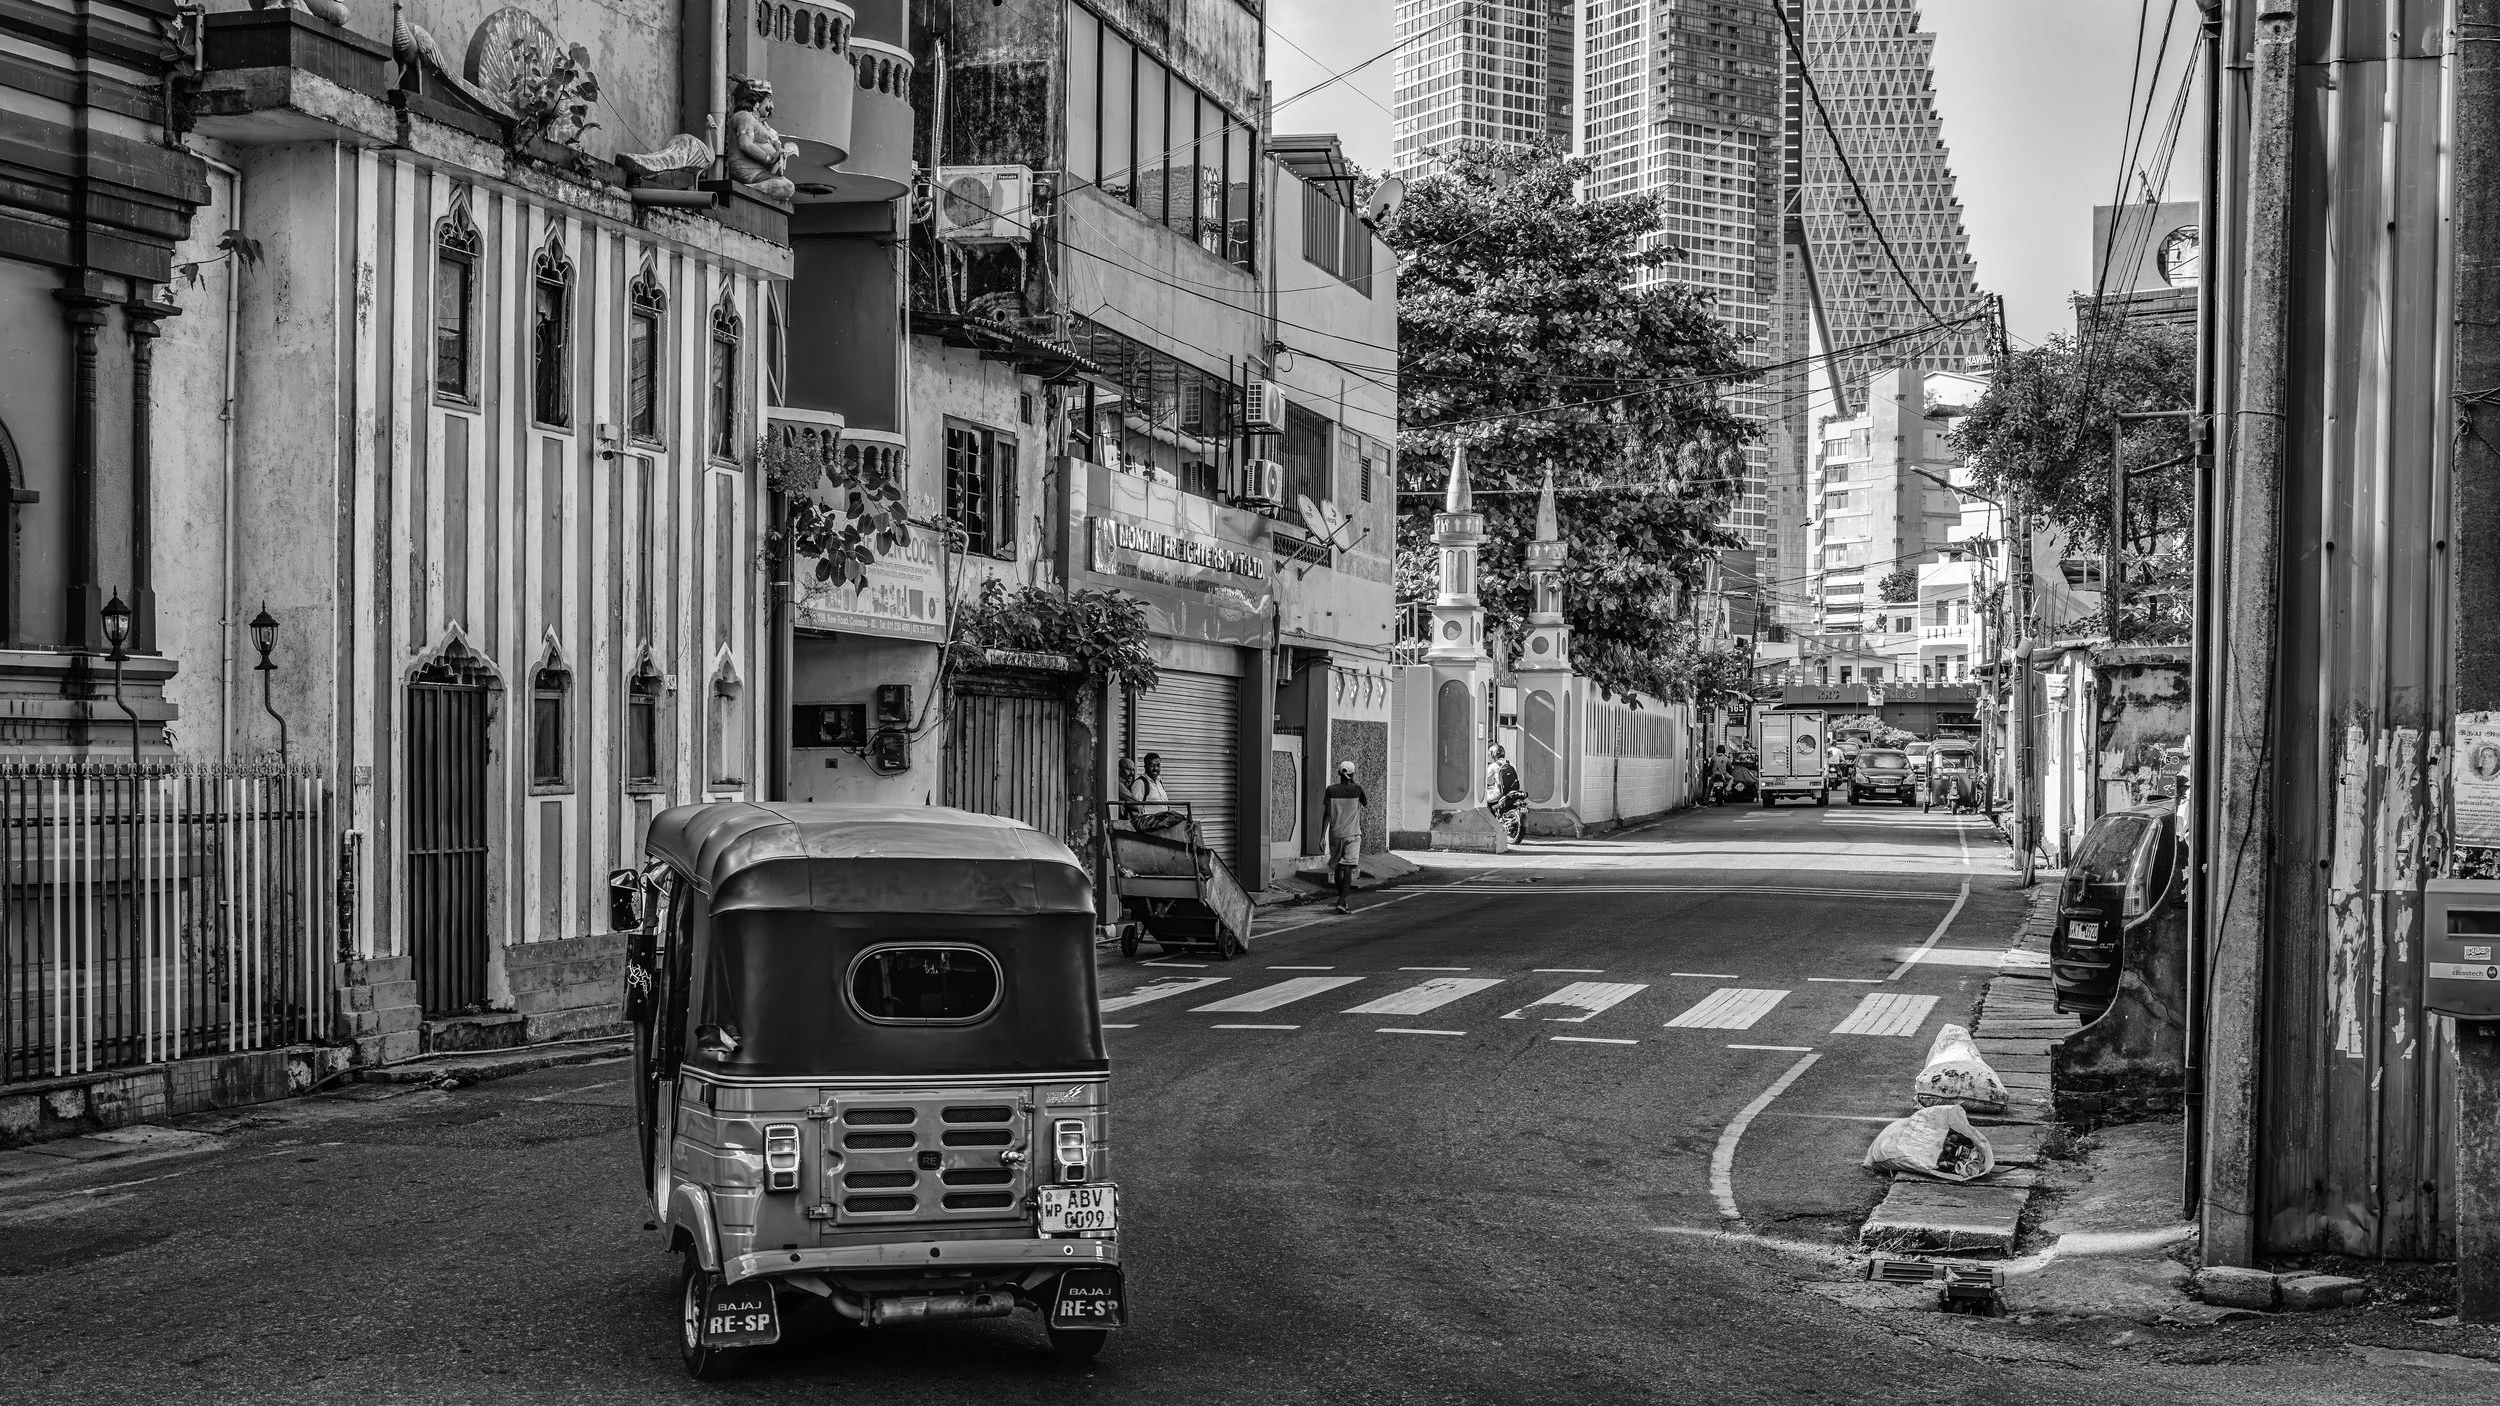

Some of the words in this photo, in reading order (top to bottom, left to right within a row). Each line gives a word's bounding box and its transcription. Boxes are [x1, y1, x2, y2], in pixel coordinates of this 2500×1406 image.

[1118, 524, 1163, 555] MONAMI
[1164, 536, 1225, 569] FREIGHTERS
[850, 616, 868, 627] Colombo
[1817, 688, 1840, 700] RRC
[922, 1157, 937, 1166] RE
[1068, 1189, 1103, 1208] ABV
[1045, 1203, 1063, 1217] WP
[1064, 1210, 1105, 1228] 0099
[1069, 1288, 1111, 1296] BAJAJ
[717, 1301, 762, 1311] BAJAJ
[709, 1313, 770, 1334] RE-SP
